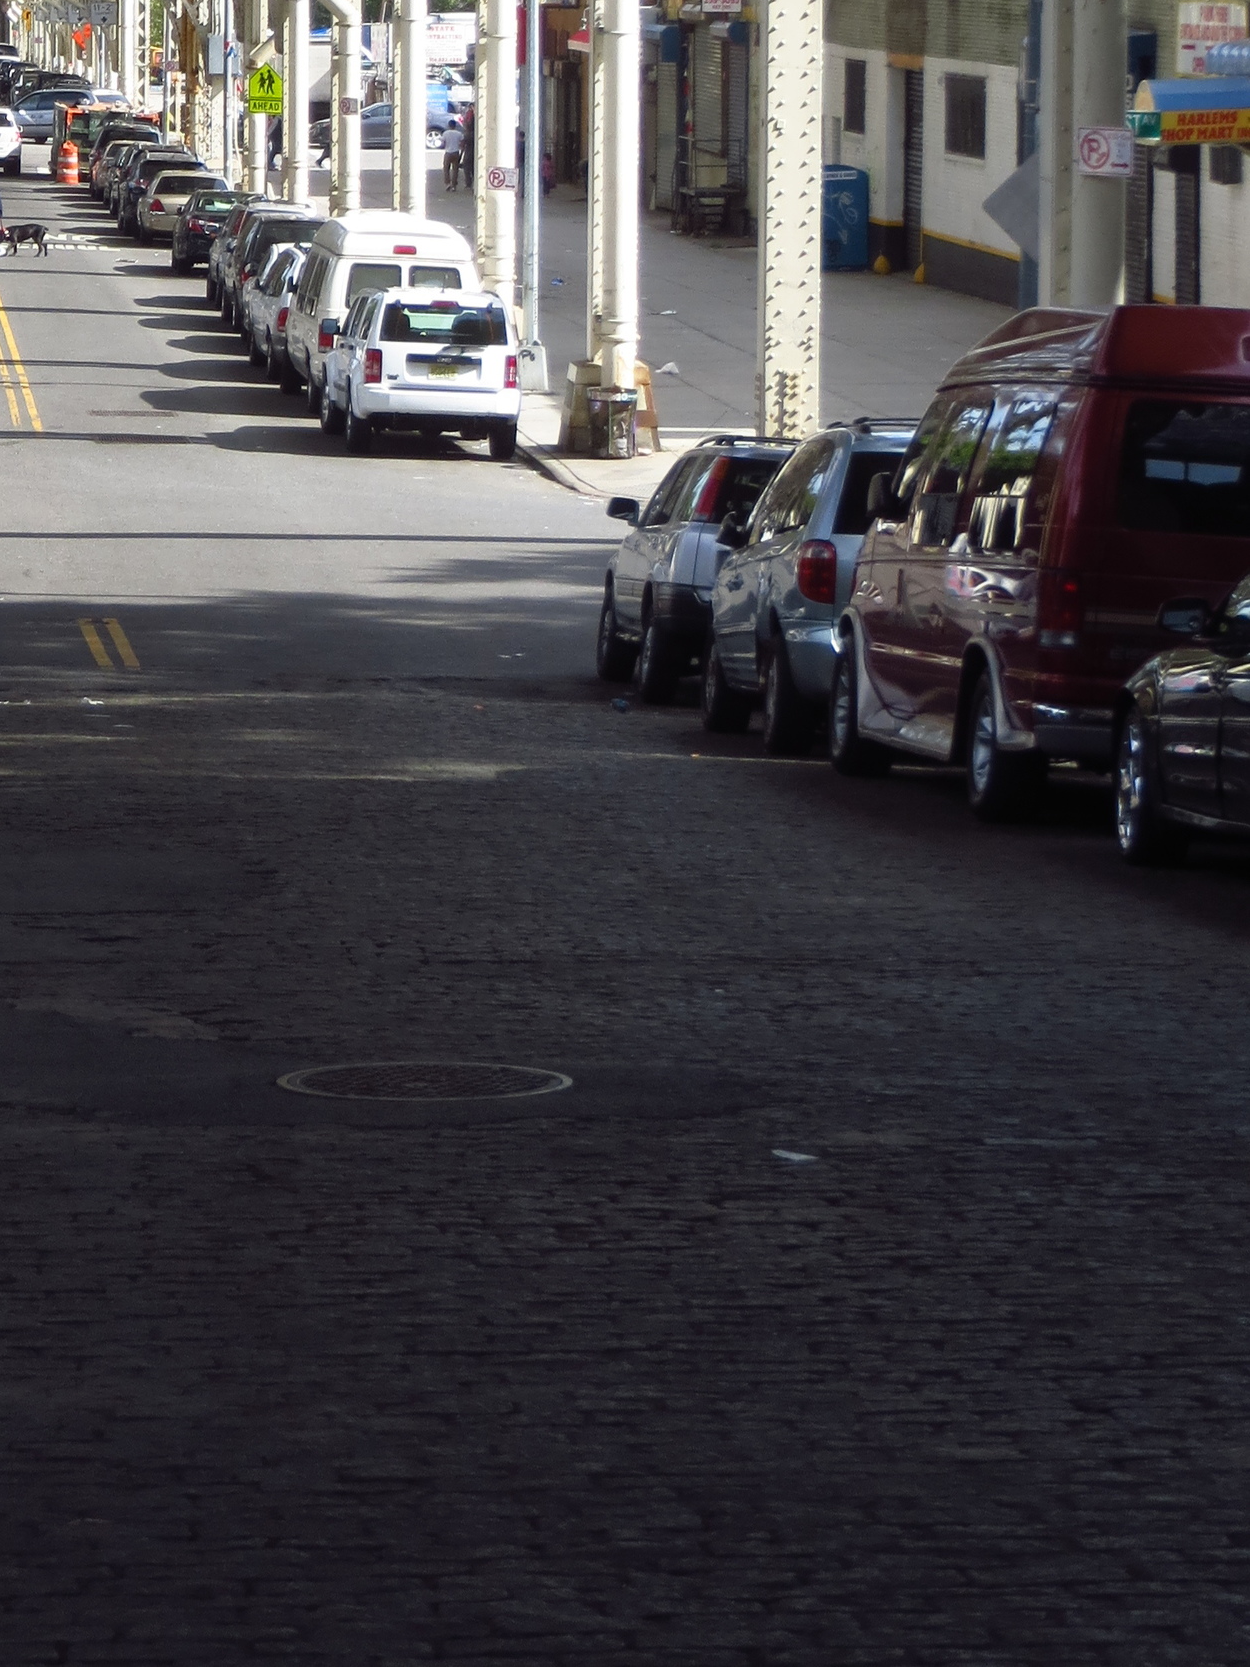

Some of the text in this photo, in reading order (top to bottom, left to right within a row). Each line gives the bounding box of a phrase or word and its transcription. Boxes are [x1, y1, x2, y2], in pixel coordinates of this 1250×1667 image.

[252, 101, 280, 111] AHEAD
[1177, 111, 1238, 126] HARLEMS
[1197, 126, 1233, 140] MART
